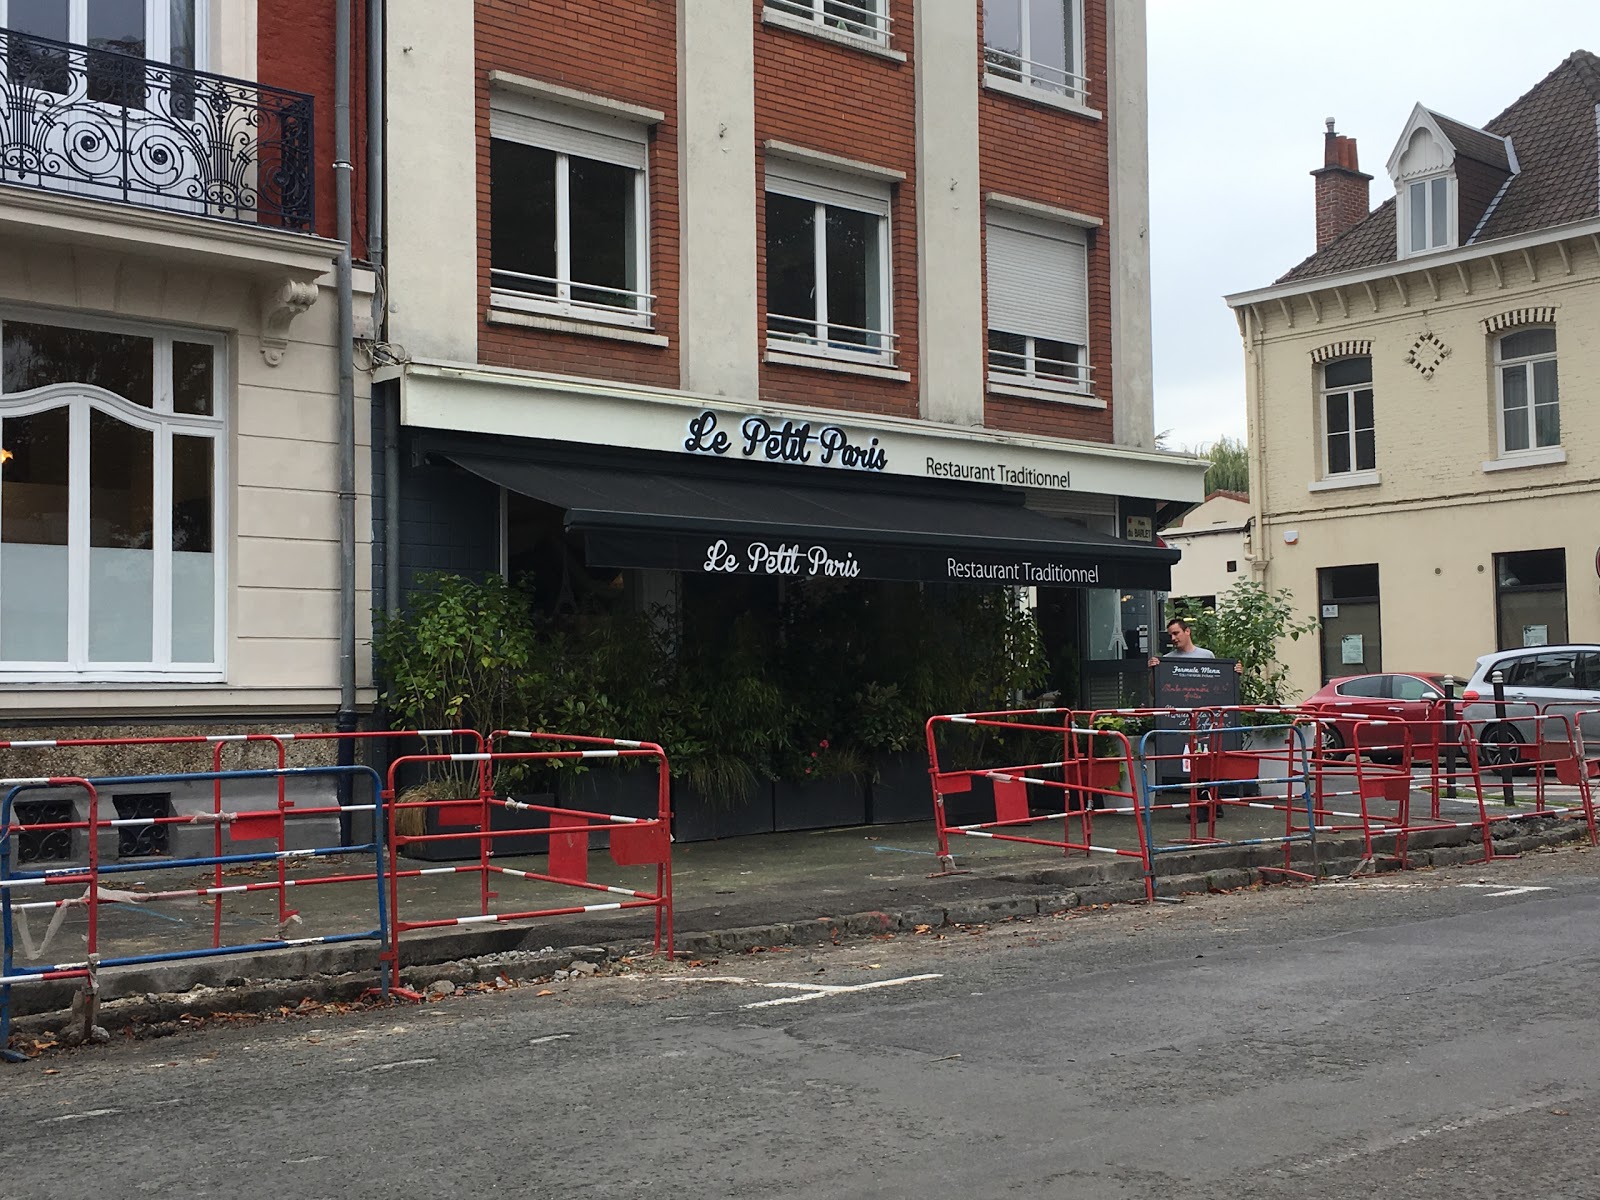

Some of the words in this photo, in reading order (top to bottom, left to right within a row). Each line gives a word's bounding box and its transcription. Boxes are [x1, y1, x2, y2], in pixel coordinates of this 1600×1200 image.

[684, 411, 731, 453] Le
[742, 418, 818, 462] Petit
[820, 427, 887, 470] Paris
[926, 457, 995, 481] Restaurant
[998, 464, 1071, 488] Traditionnel
[703, 539, 739, 572] Le
[747, 542, 806, 575] Petit
[807, 546, 860, 578] Paris
[947, 557, 1019, 580] Restaurant
[1022, 562, 1099, 583] Traditionnel
